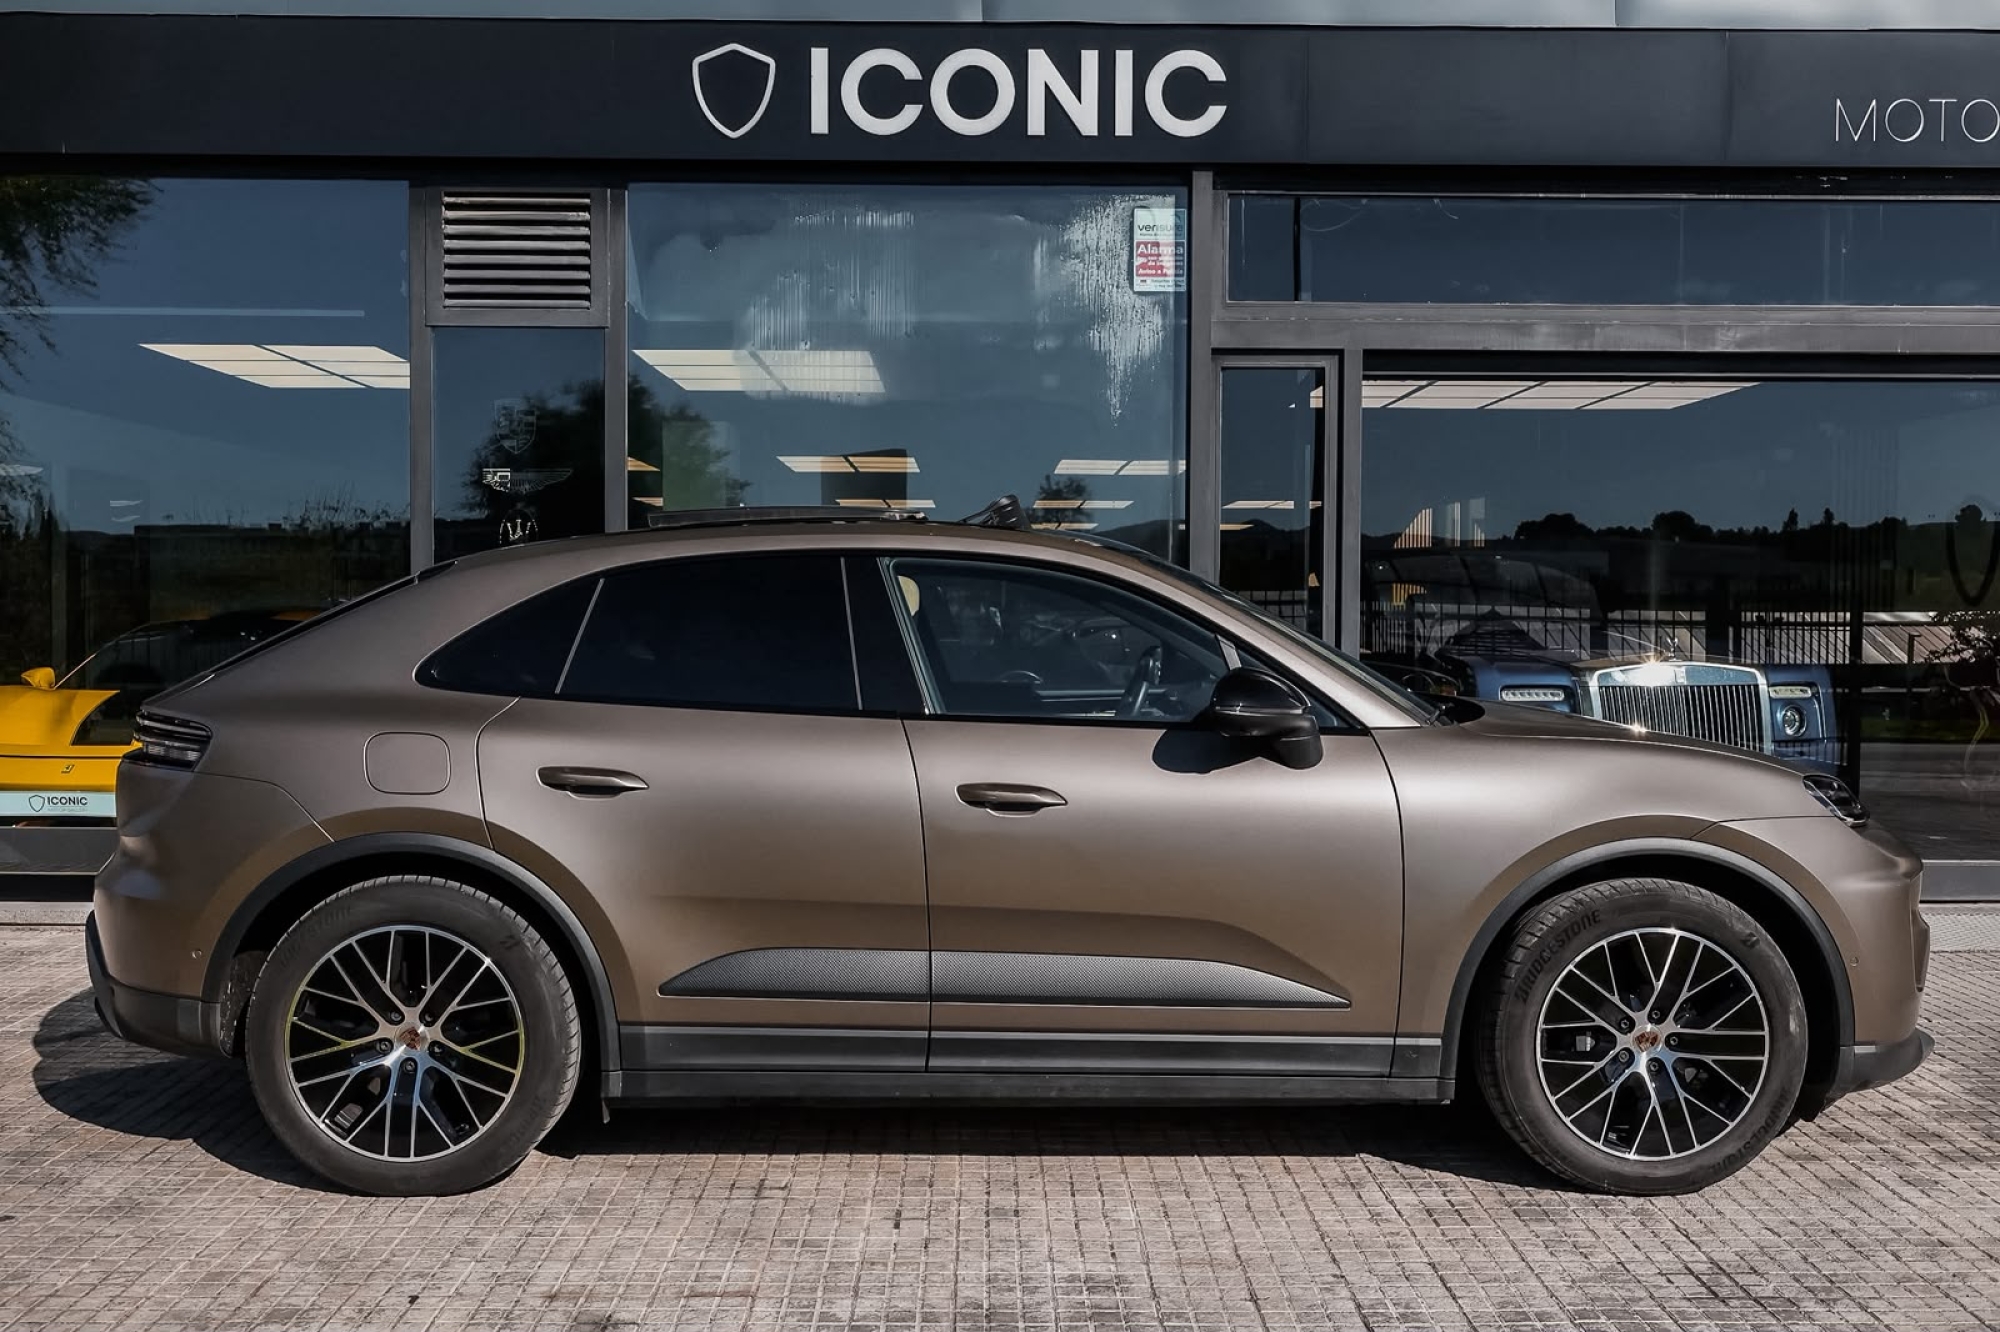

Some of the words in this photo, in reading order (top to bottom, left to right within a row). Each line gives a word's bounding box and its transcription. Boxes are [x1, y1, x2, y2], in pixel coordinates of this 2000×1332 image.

[810, 47, 1227, 137] ICONIC
[1835, 98, 2000, 143] MOTO
[1138, 224, 1183, 232] verisue
[1138, 244, 1183, 254] Alarma
[47, 796, 88, 806] ICONIC
